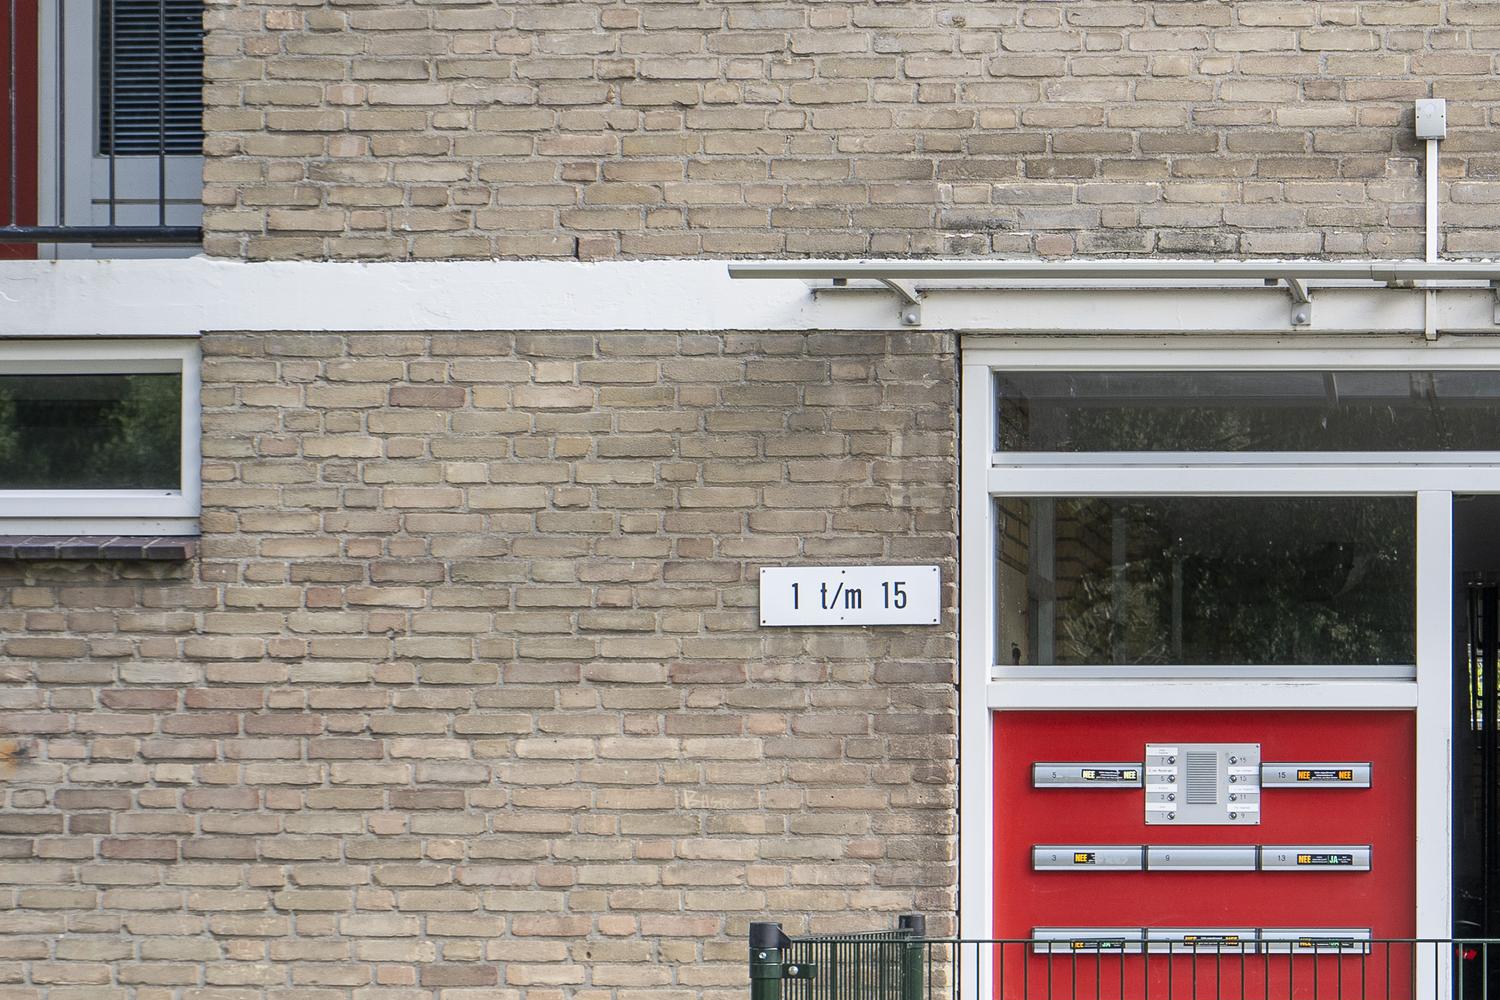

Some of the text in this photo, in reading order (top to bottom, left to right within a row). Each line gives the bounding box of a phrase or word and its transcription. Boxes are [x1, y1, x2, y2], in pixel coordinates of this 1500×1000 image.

[791, 581, 907, 609] 1 t/m 15
[1051, 771, 1057, 779] 5
[1082, 770, 1096, 779] NEE
[1123, 770, 1137, 780] NEE
[1278, 771, 1287, 779] 15
[1298, 770, 1311, 779] NEE
[1338, 770, 1352, 779] NEE
[1051, 854, 1057, 862] 3
[1074, 853, 1088, 862] NEE
[1165, 854, 1170, 862] 9
[1277, 854, 1286, 862] 13
[1298, 855, 1312, 864] NEE
[1328, 855, 1339, 864] JA
